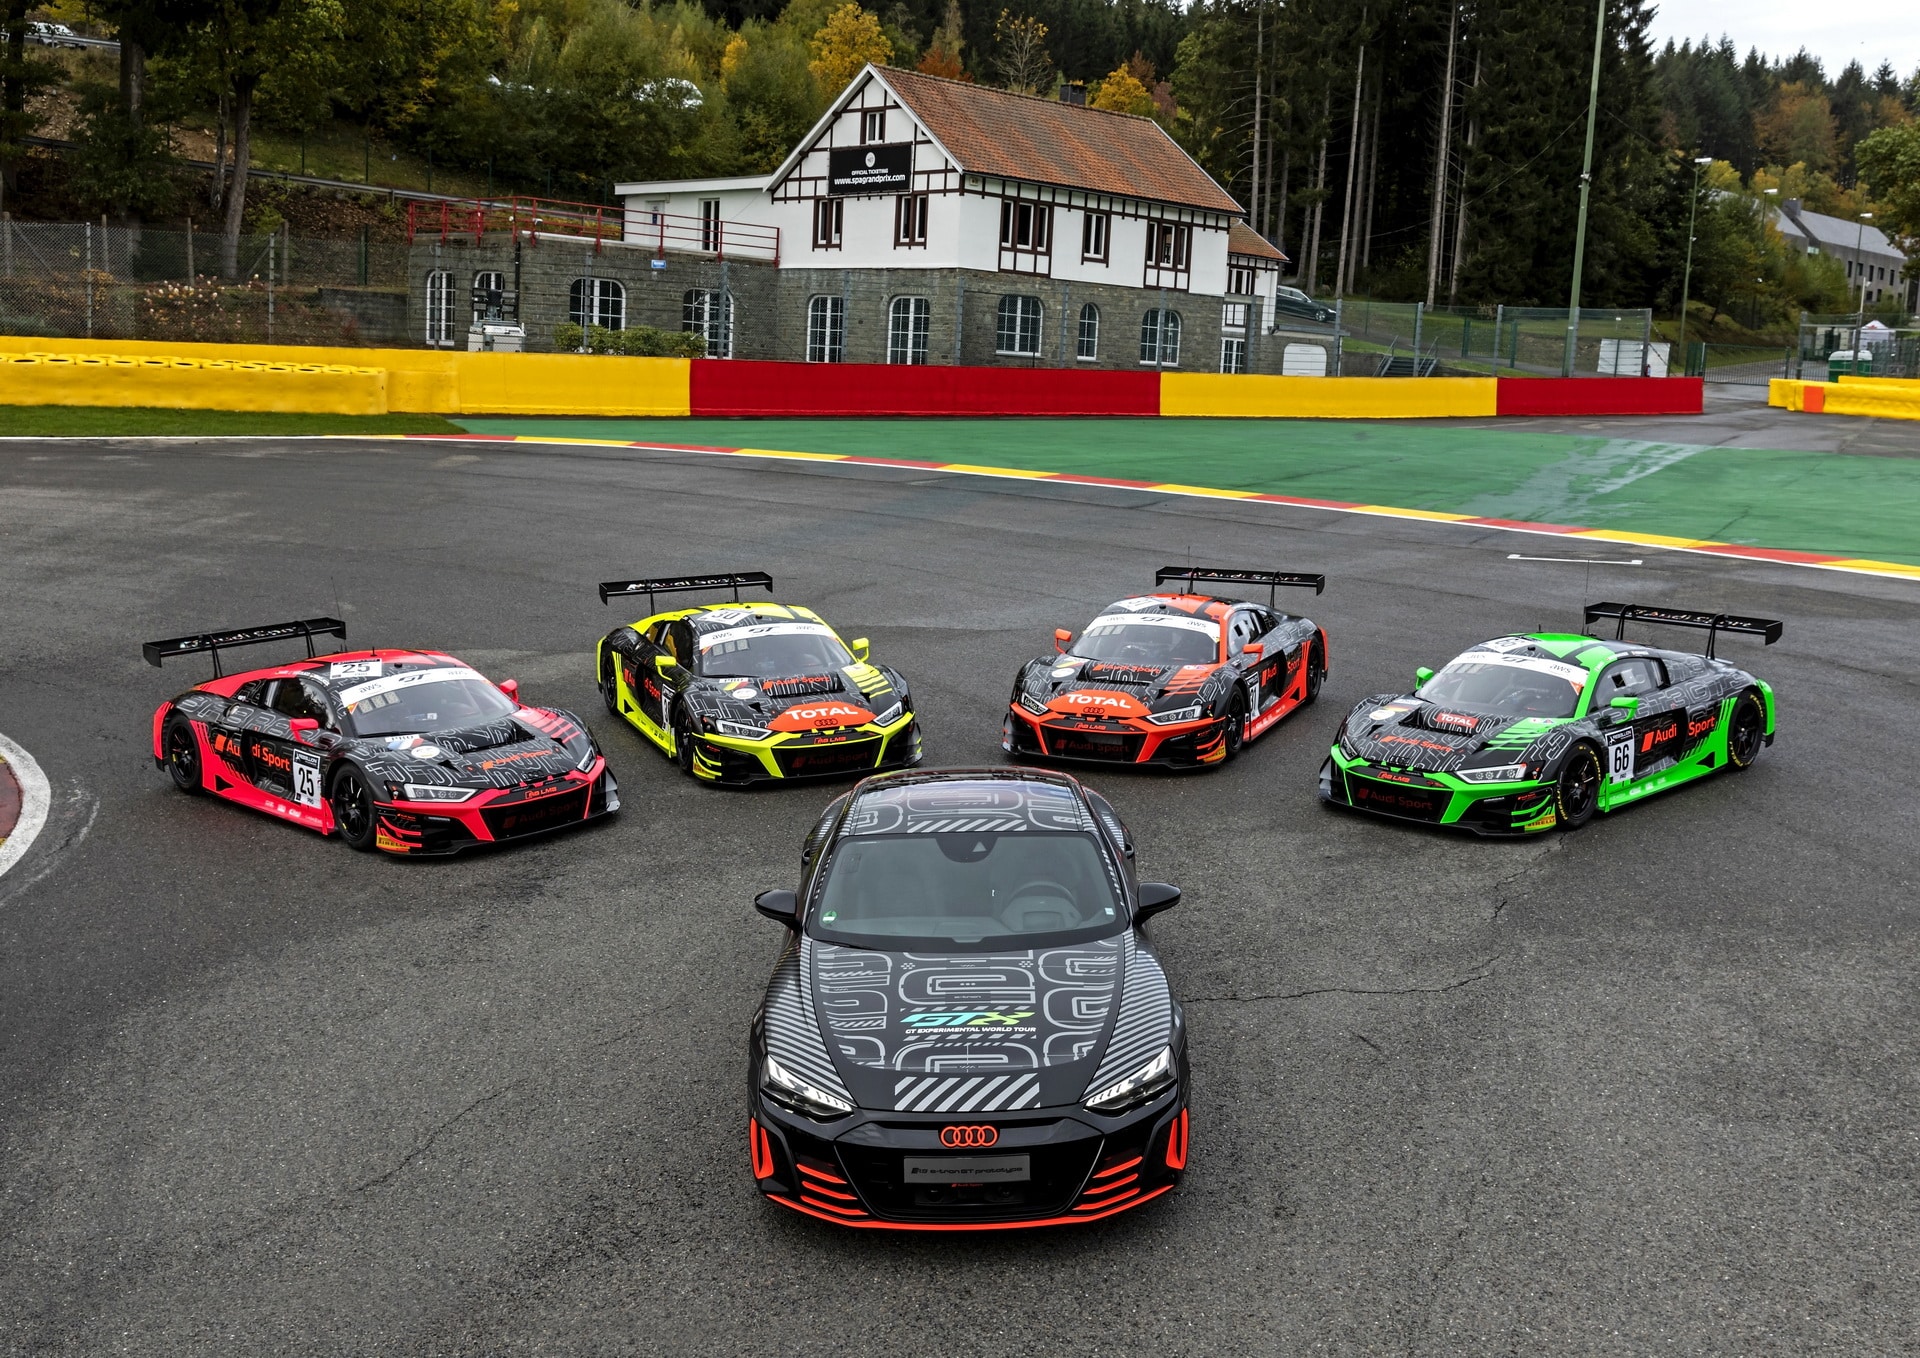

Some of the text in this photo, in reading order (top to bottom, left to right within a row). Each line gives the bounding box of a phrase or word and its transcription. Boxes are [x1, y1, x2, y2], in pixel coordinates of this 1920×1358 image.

[834, 174, 906, 185] www.spagrandprix.com
[341, 662, 371, 674] 25
[1066, 693, 1132, 709] TOTAL
[785, 706, 859, 720] TOTAL
[1440, 713, 1473, 726] TOTAL
[1654, 715, 1716, 745] Audi Sport
[226, 738, 291, 772] Audi Sport
[1614, 743, 1630, 774] 66
[298, 767, 315, 797] 25
[540, 786, 558, 796] LMS
[1370, 791, 1433, 811] Audi Sport
[900, 1011, 1036, 1028] GTX
[975, 1166, 1023, 1175] prototype
